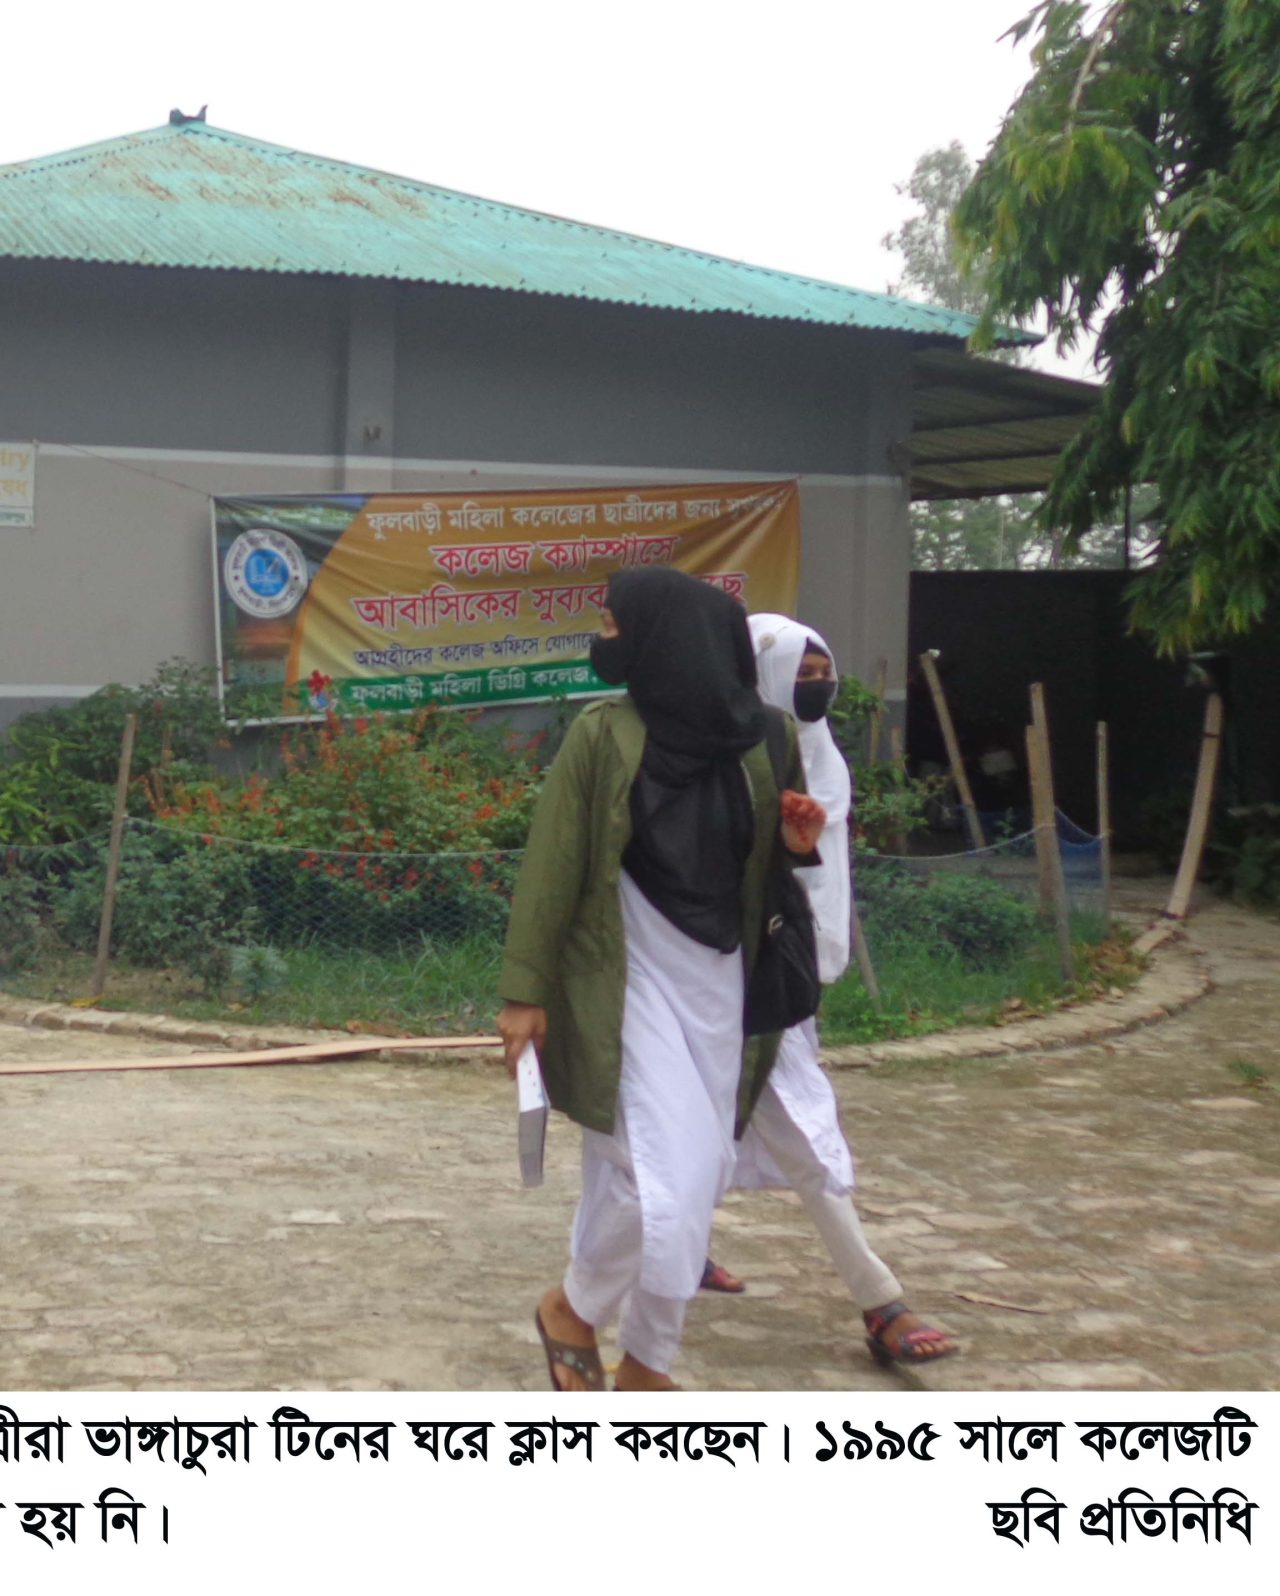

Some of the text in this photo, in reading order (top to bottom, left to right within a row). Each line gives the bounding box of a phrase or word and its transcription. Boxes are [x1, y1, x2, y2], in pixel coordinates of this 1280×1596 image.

[366, 503, 442, 540] ফুলবাড়ী
[448, 500, 504, 530] মহিলা
[512, 503, 596, 527] কলেজের
[603, 494, 677, 524] ছাত্রীদের
[429, 533, 680, 578] কলেজ ক্যাম্পাসে
[352, 582, 609, 630] আবাসিকের সুব্যব
[440, 642, 485, 663] কলেজ
[351, 675, 424, 705] ফুলবাড়ী
[429, 673, 482, 698] মহিলা
